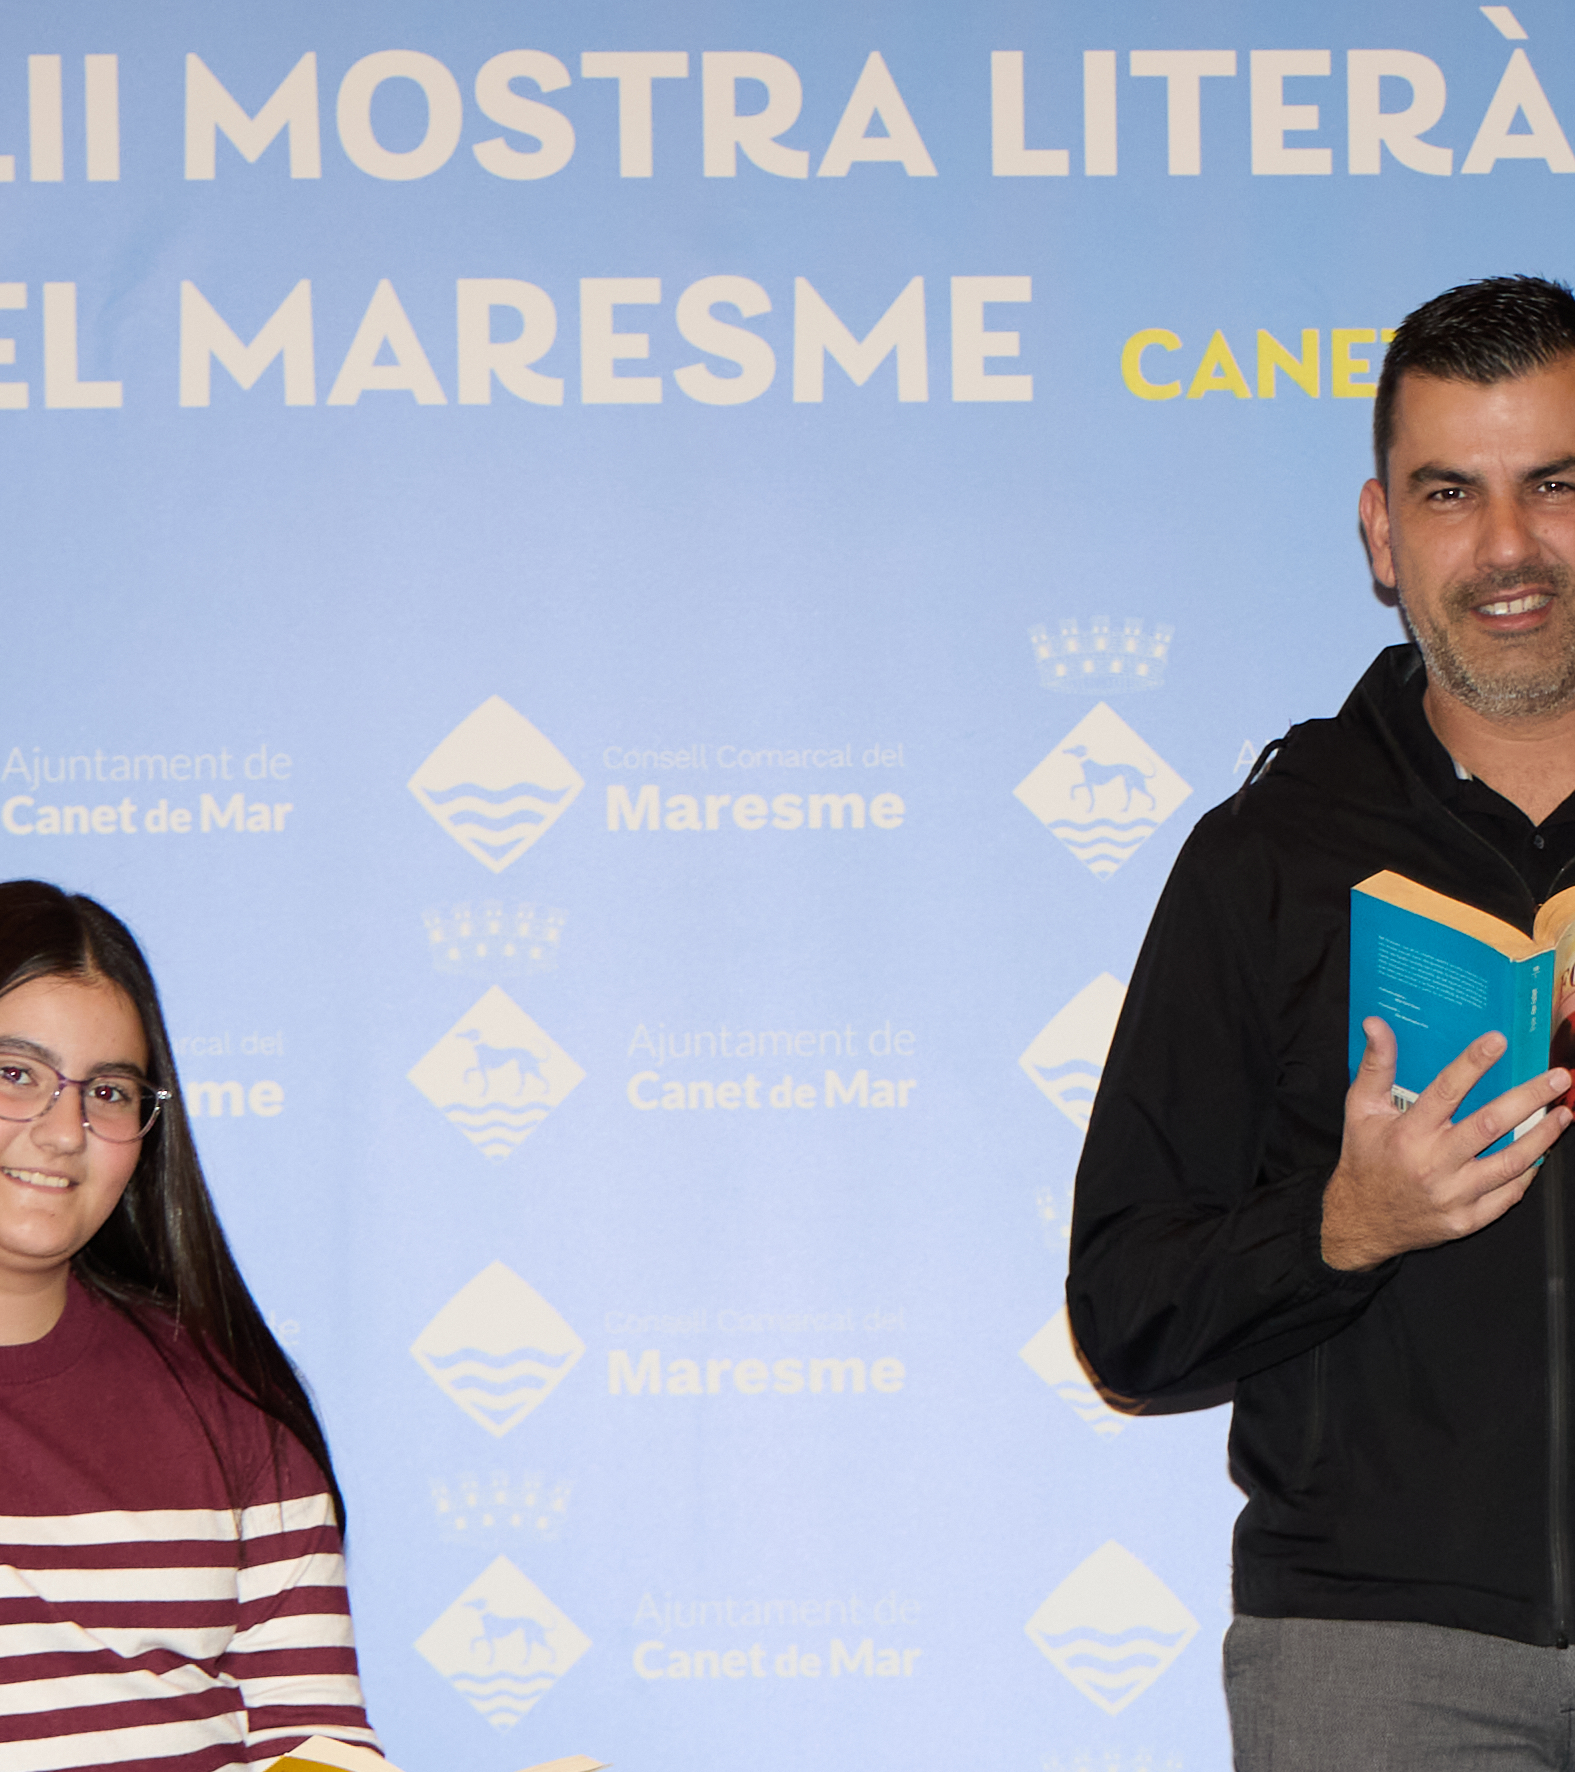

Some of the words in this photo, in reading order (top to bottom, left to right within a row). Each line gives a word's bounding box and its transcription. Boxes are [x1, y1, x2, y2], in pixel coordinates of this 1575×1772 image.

[185, 50, 937, 180] MOSTRA
[180, 275, 1033, 407] MARESME
[1122, 329, 1396, 400] CANE
[2, 747, 232, 790] Ajuntament
[243, 744, 292, 780] de
[603, 744, 708, 770] Consell
[716, 744, 853, 769] Comarcal
[862, 743, 904, 768] del
[2, 796, 137, 835] Canet
[145, 799, 192, 833] de
[201, 793, 293, 832] Mar
[607, 785, 905, 831] Maresme
[627, 1022, 859, 1067] Ajuntament
[868, 1021, 915, 1057] de
[627, 1071, 761, 1110] Canet
[769, 1075, 816, 1108] de
[825, 1070, 916, 1107] Mar
[608, 1350, 905, 1395] Maresme
